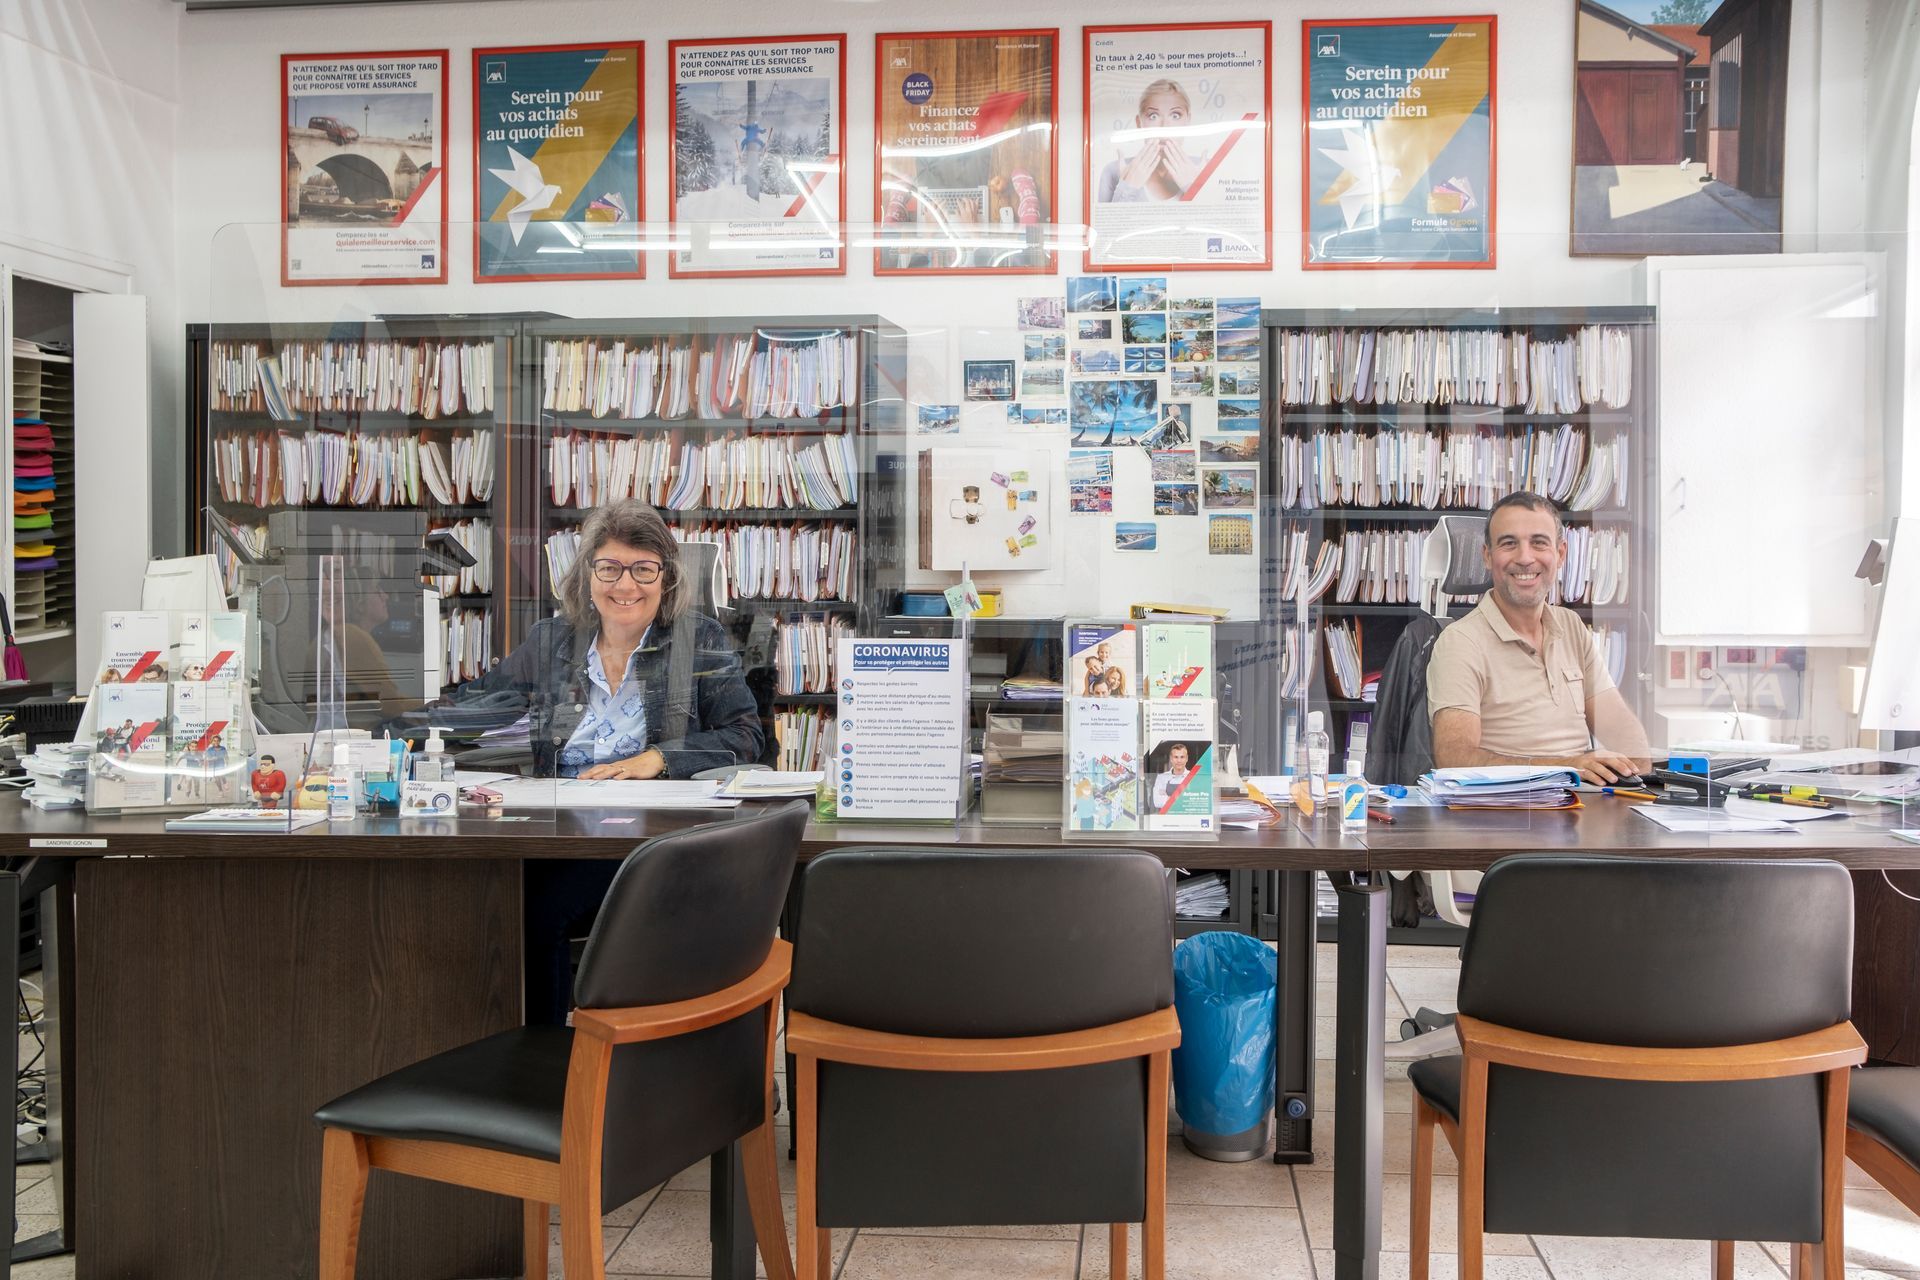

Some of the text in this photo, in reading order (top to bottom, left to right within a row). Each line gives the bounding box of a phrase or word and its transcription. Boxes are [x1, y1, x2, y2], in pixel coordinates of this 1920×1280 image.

[681, 51, 728, 60] N'ATTENDEZ
[768, 57, 806, 65] SERVICES
[1167, 53, 1185, 61] pour
[357, 64, 375, 72] QU'IL
[1204, 60, 1254, 68] promotionnel
[765, 66, 813, 74] ASSURANCE
[1346, 65, 1449, 83] Serein pour
[512, 89, 603, 105] Serein pour
[1331, 84, 1421, 99] vos achats
[500, 107, 578, 122] vos achats
[920, 106, 979, 117] Financez
[1316, 102, 1427, 120] au quotidien
[909, 120, 976, 131] vos achats
[487, 124, 584, 143] au quotidien
[1412, 218, 1447, 226] Formule
[855, 646, 948, 657] CORONAVIRUS
